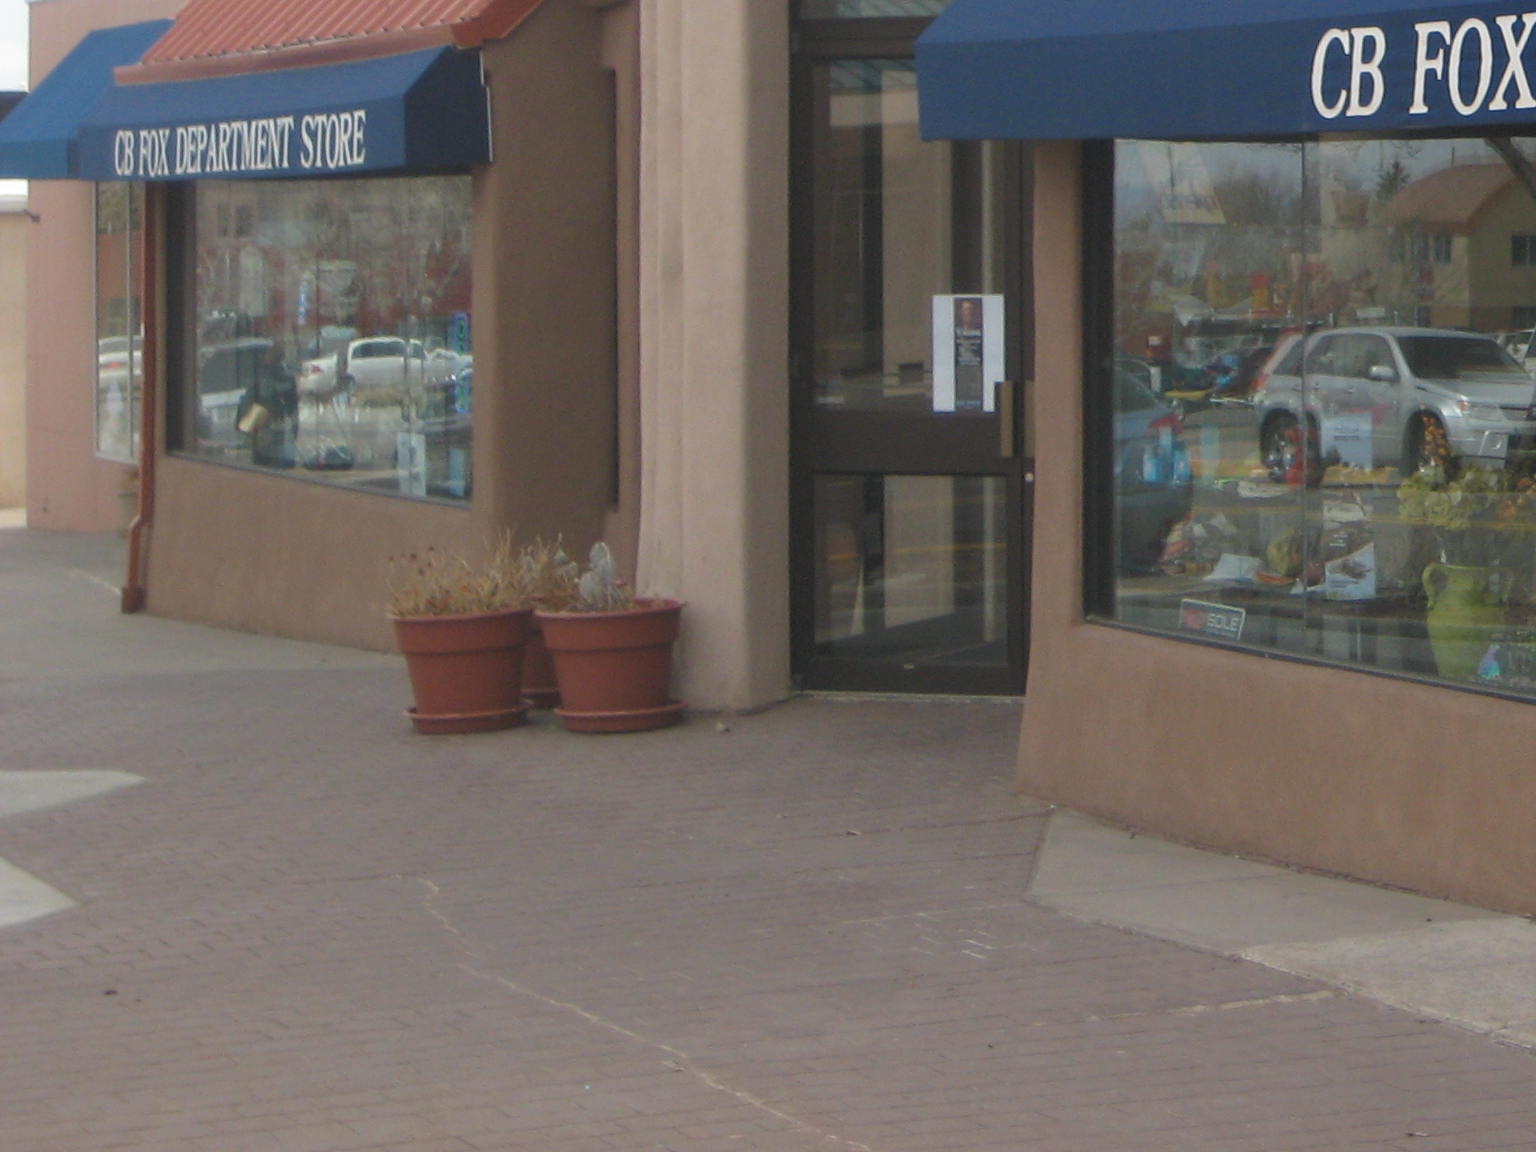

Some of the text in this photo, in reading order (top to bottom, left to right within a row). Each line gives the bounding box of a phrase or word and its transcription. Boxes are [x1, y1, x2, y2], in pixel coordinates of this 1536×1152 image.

[1311, 26, 1386, 119] CB
[114, 109, 366, 177] CB FOX DEPARTMENT STORE
